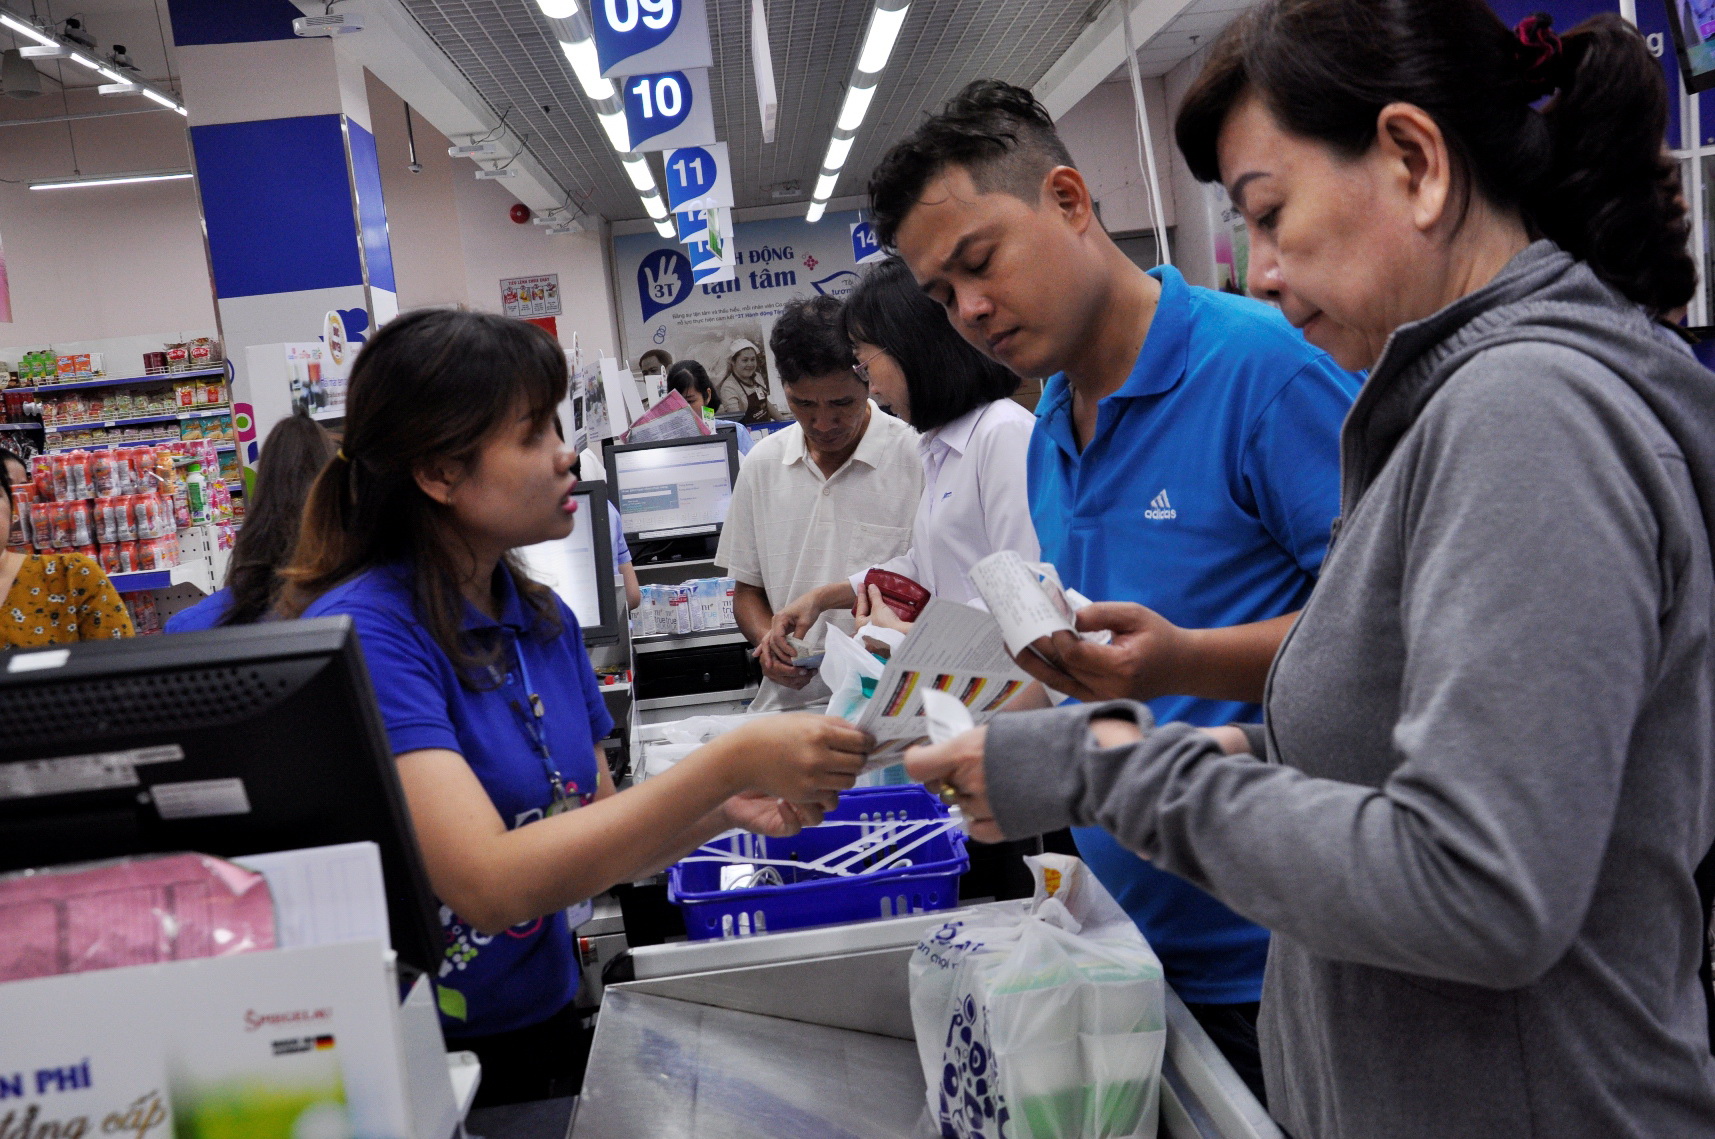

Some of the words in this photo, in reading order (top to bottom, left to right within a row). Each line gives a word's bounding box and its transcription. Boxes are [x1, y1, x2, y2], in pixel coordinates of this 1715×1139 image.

[632, 77, 682, 118] 10
[673, 158, 703, 187] 11
[856, 230, 877, 248] 14
[749, 245, 794, 265] ĐỘNG
[748, 268, 797, 290] tâm
[654, 283, 674, 298] 3T
[1144, 508, 1177, 520] adidas
[35, 1057, 91, 1095] PHÍ
